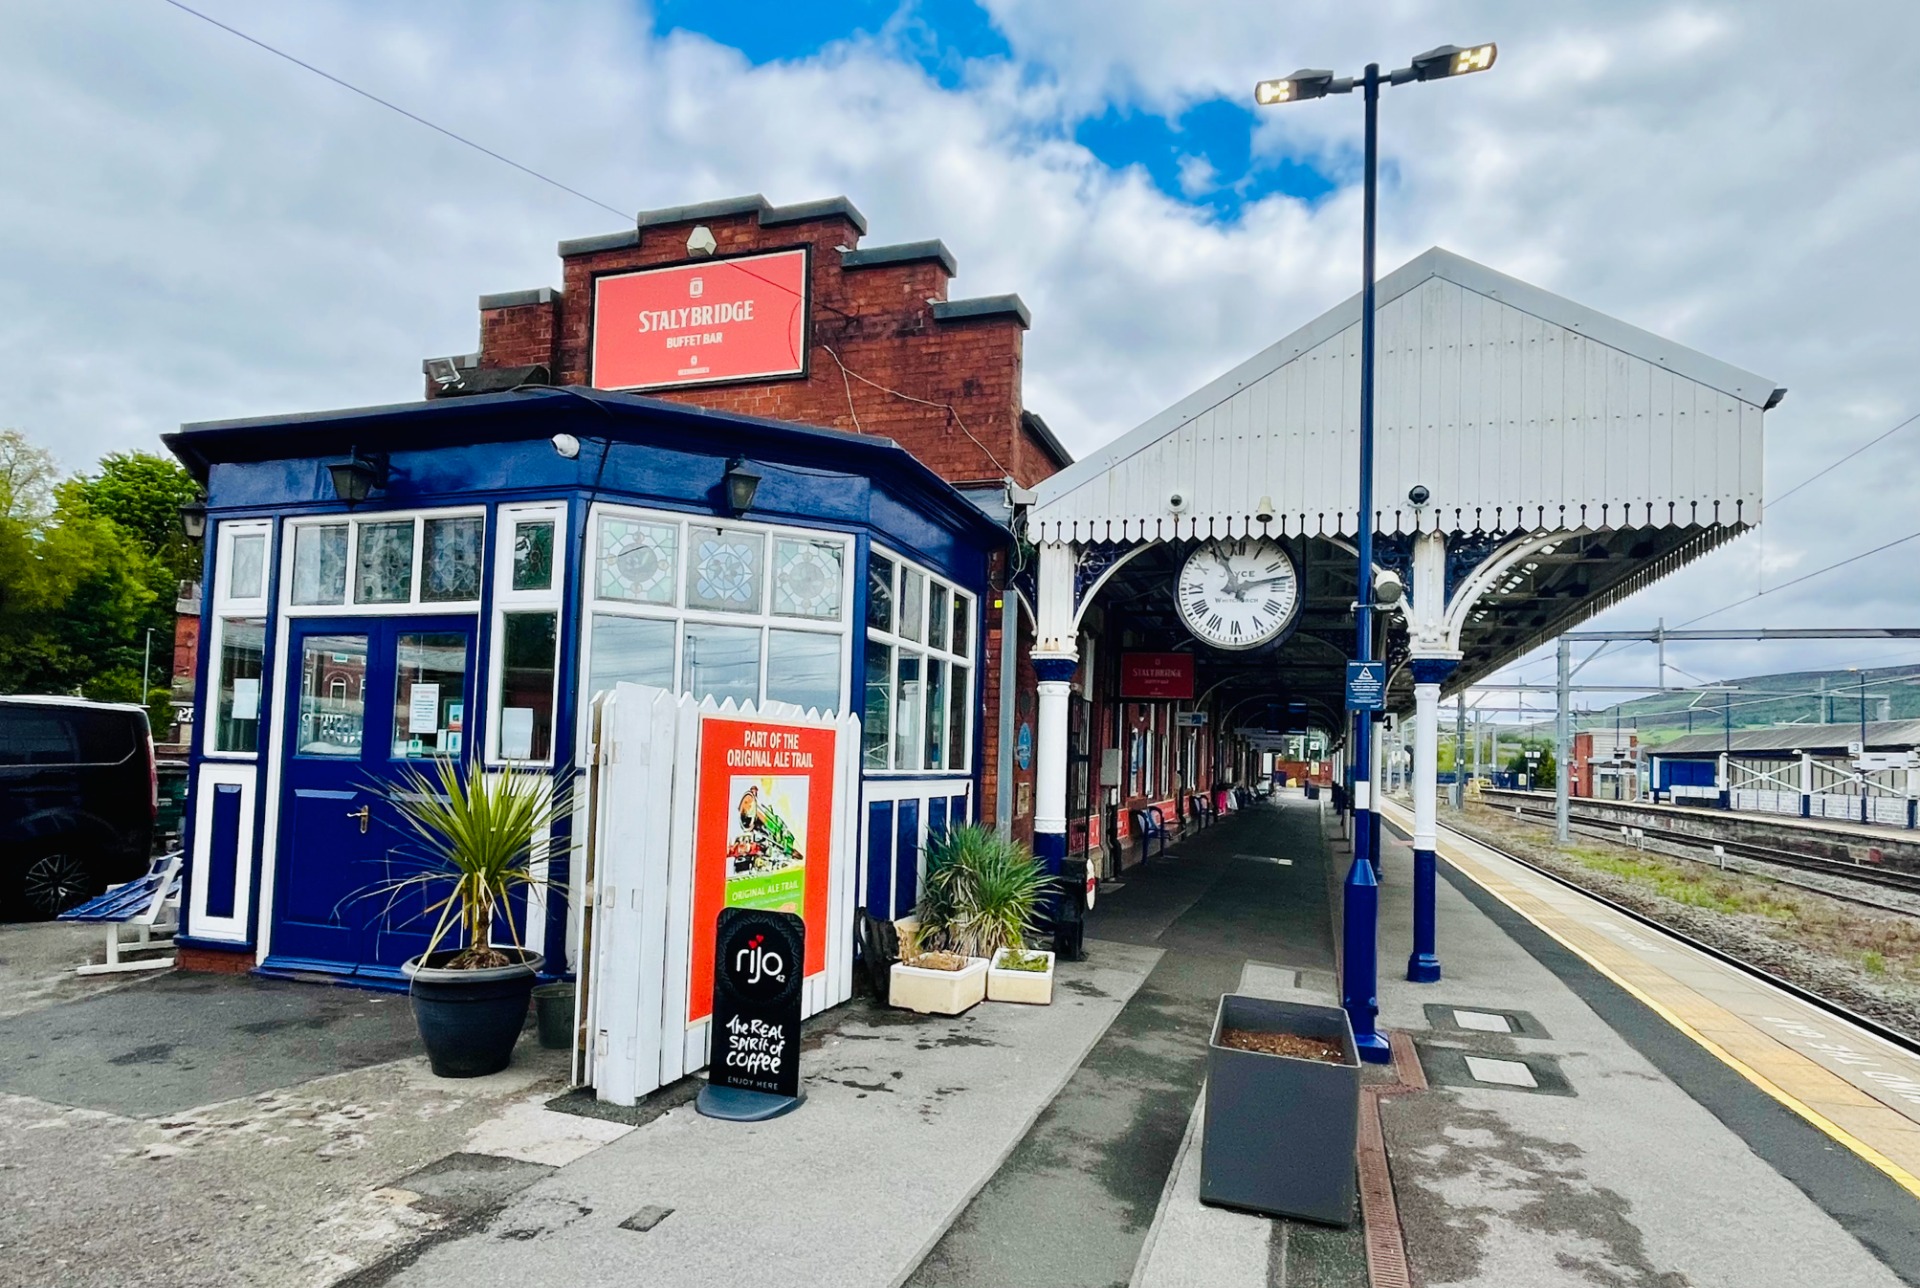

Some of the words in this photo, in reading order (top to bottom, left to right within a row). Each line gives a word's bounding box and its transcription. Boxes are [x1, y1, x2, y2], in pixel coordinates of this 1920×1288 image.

[639, 300, 754, 333] STALYBRIDGE
[666, 334, 701, 349] BUFFET
[703, 332, 723, 345] BAR
[1219, 570, 1256, 578] JYCE
[744, 730, 768, 748] PART
[770, 732, 782, 749] OF
[783, 733, 800, 750] THE
[727, 749, 772, 767] ORIGINAL
[773, 751, 790, 768] ALE
[791, 752, 814, 768] TRAIL
[732, 886, 766, 902] ORIGINAL
[767, 883, 780, 894] ALE
[781, 880, 799, 891] TRAIL
[725, 1014, 749, 1035] The
[769, 1040, 786, 1057] of
[727, 1076, 754, 1086] ENJOY
[756, 1081, 779, 1091] HERE
